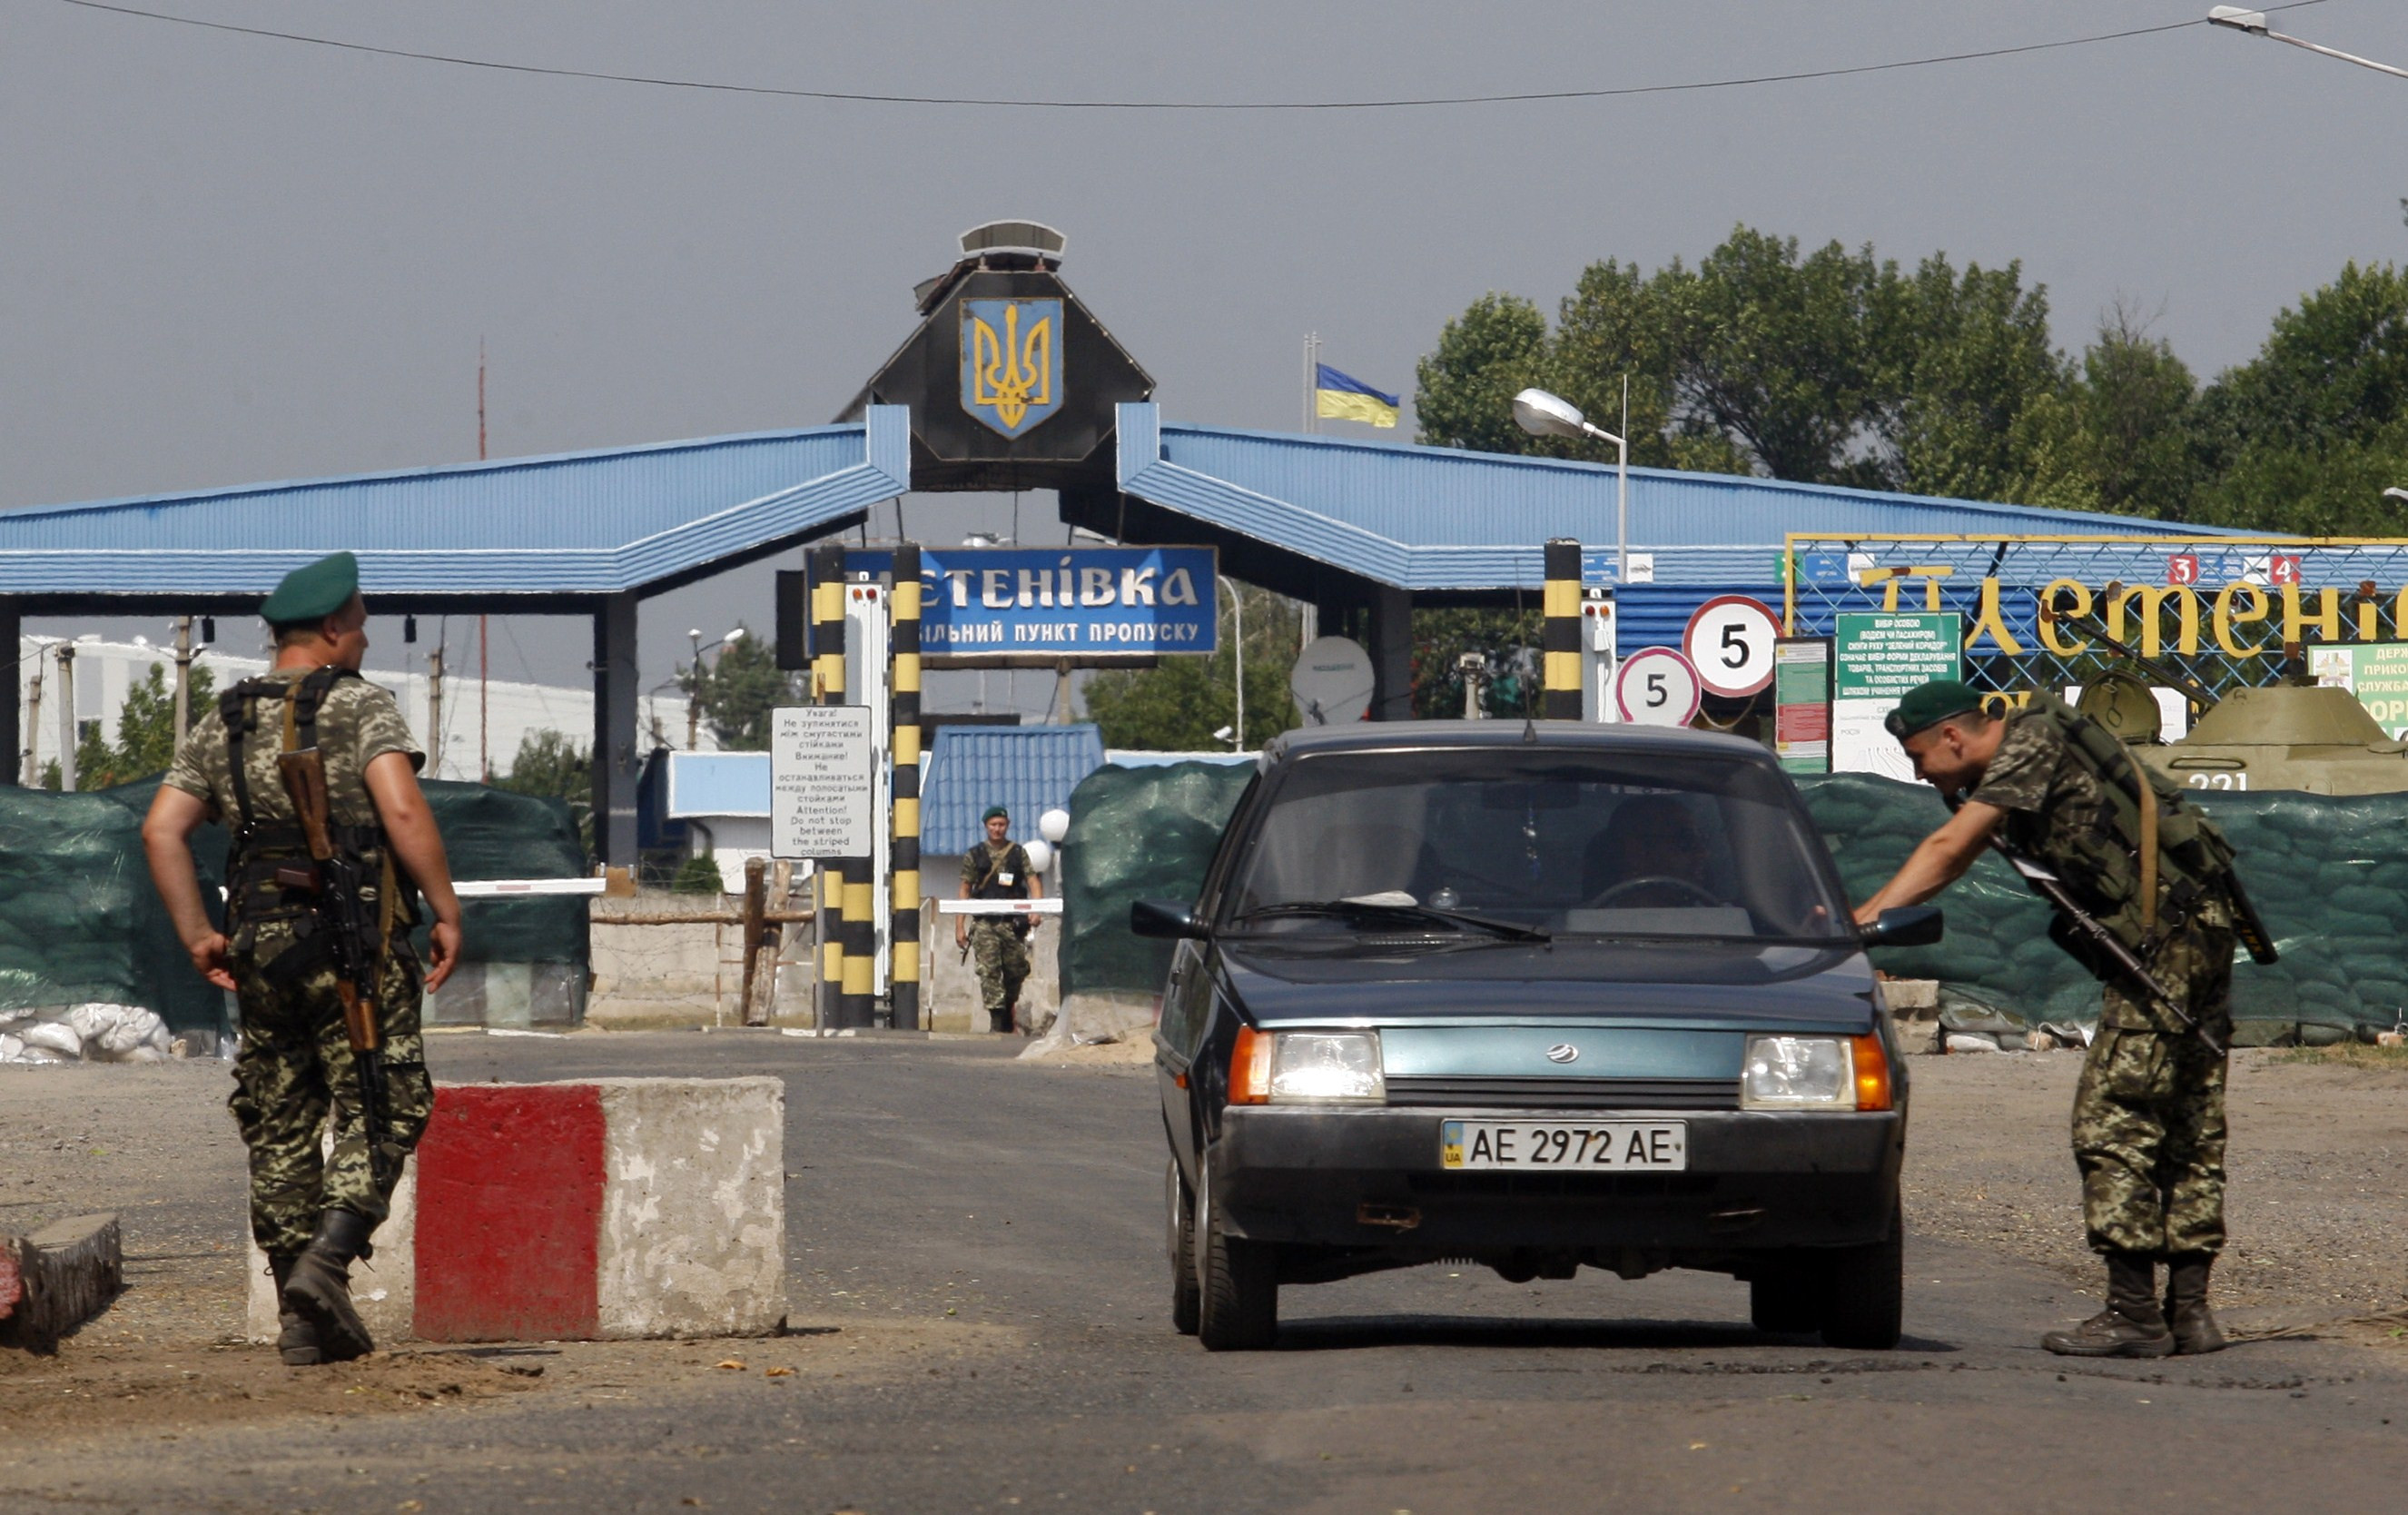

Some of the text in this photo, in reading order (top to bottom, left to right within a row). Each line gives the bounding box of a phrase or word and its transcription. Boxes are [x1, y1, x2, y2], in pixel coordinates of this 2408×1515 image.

[2175, 559, 2190, 581] 3
[2275, 560, 2291, 582] 4
[844, 556, 1199, 607] ЕТЕНІВКА
[919, 619, 1199, 643] ІЛЬНИЙ ПУНКТ ПРОПУСКУ
[1721, 624, 1750, 668] 5
[2364, 664, 2408, 675] ПРИКО
[1646, 674, 1667, 707] 5
[806, 708, 837, 718] Увага!
[784, 719, 796, 728] Не
[814, 763, 828, 771] Не
[796, 806, 847, 815] Attention!
[791, 817, 852, 826] Do not stop
[800, 827, 843, 836] between
[793, 837, 850, 847] the striped
[1470, 1128, 1672, 1164] AE 2972 AE
[1446, 1152, 1462, 1163] UA
